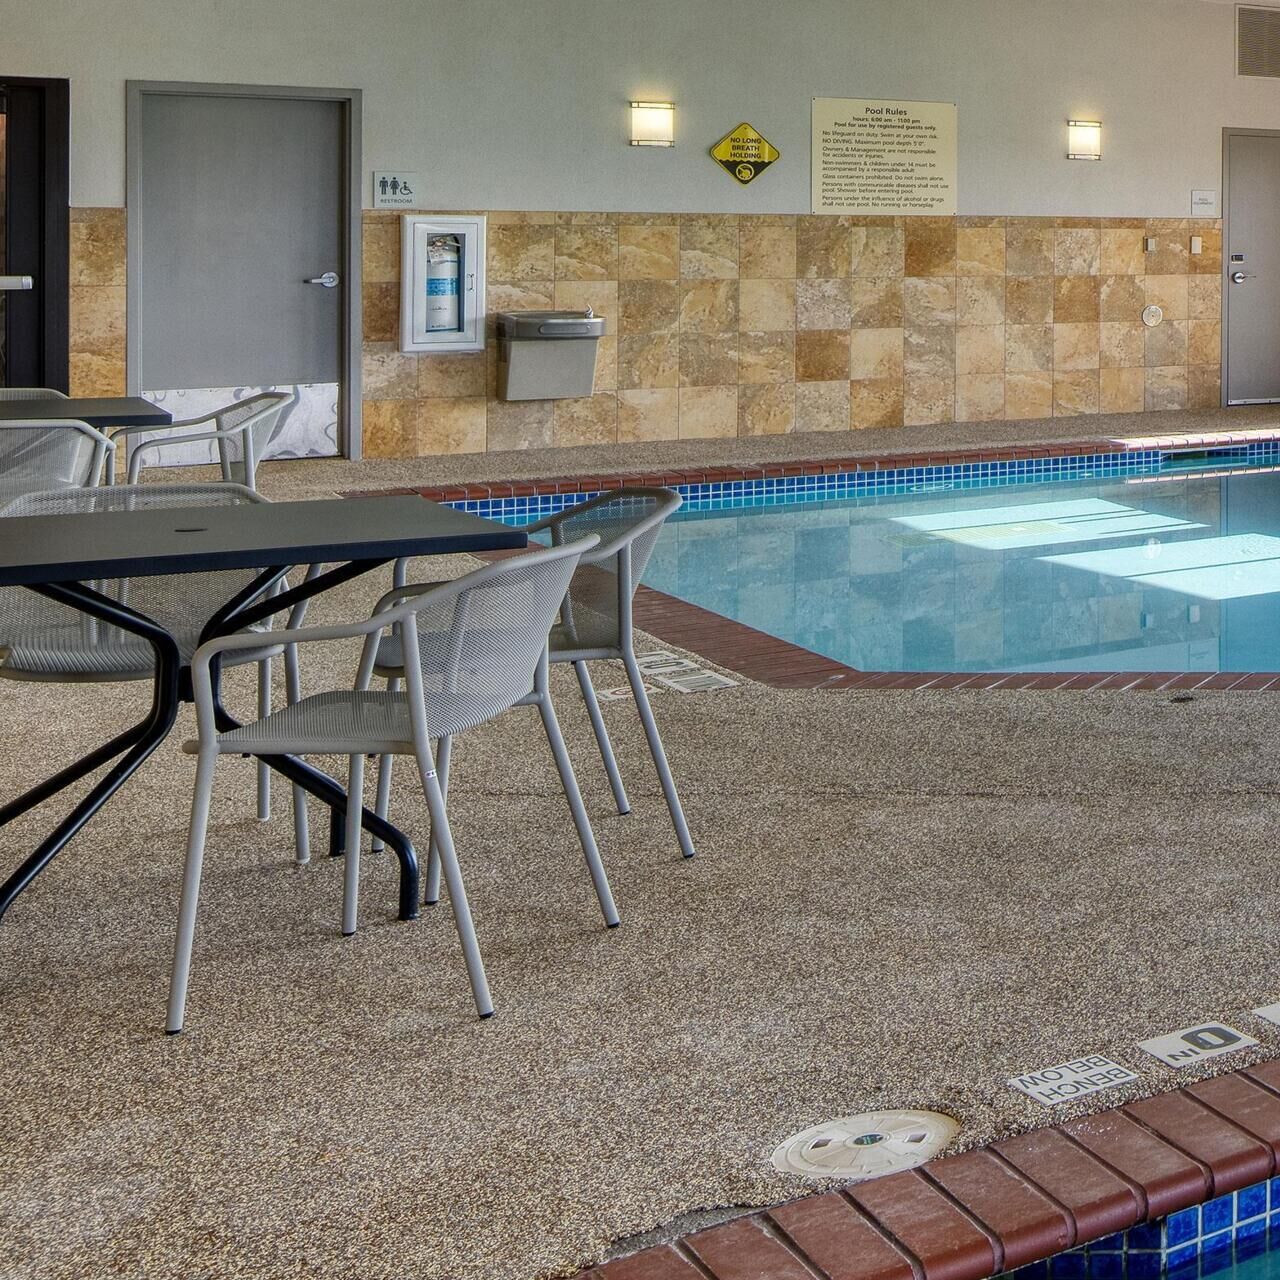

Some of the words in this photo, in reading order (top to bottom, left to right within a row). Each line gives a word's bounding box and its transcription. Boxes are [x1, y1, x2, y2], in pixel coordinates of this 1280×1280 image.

[1180, 1026, 1242, 1050] 0
[1166, 1047, 1202, 1062] IN
[1018, 1055, 1111, 1090] BELOW
[1038, 1068, 1132, 1100] BENCH
